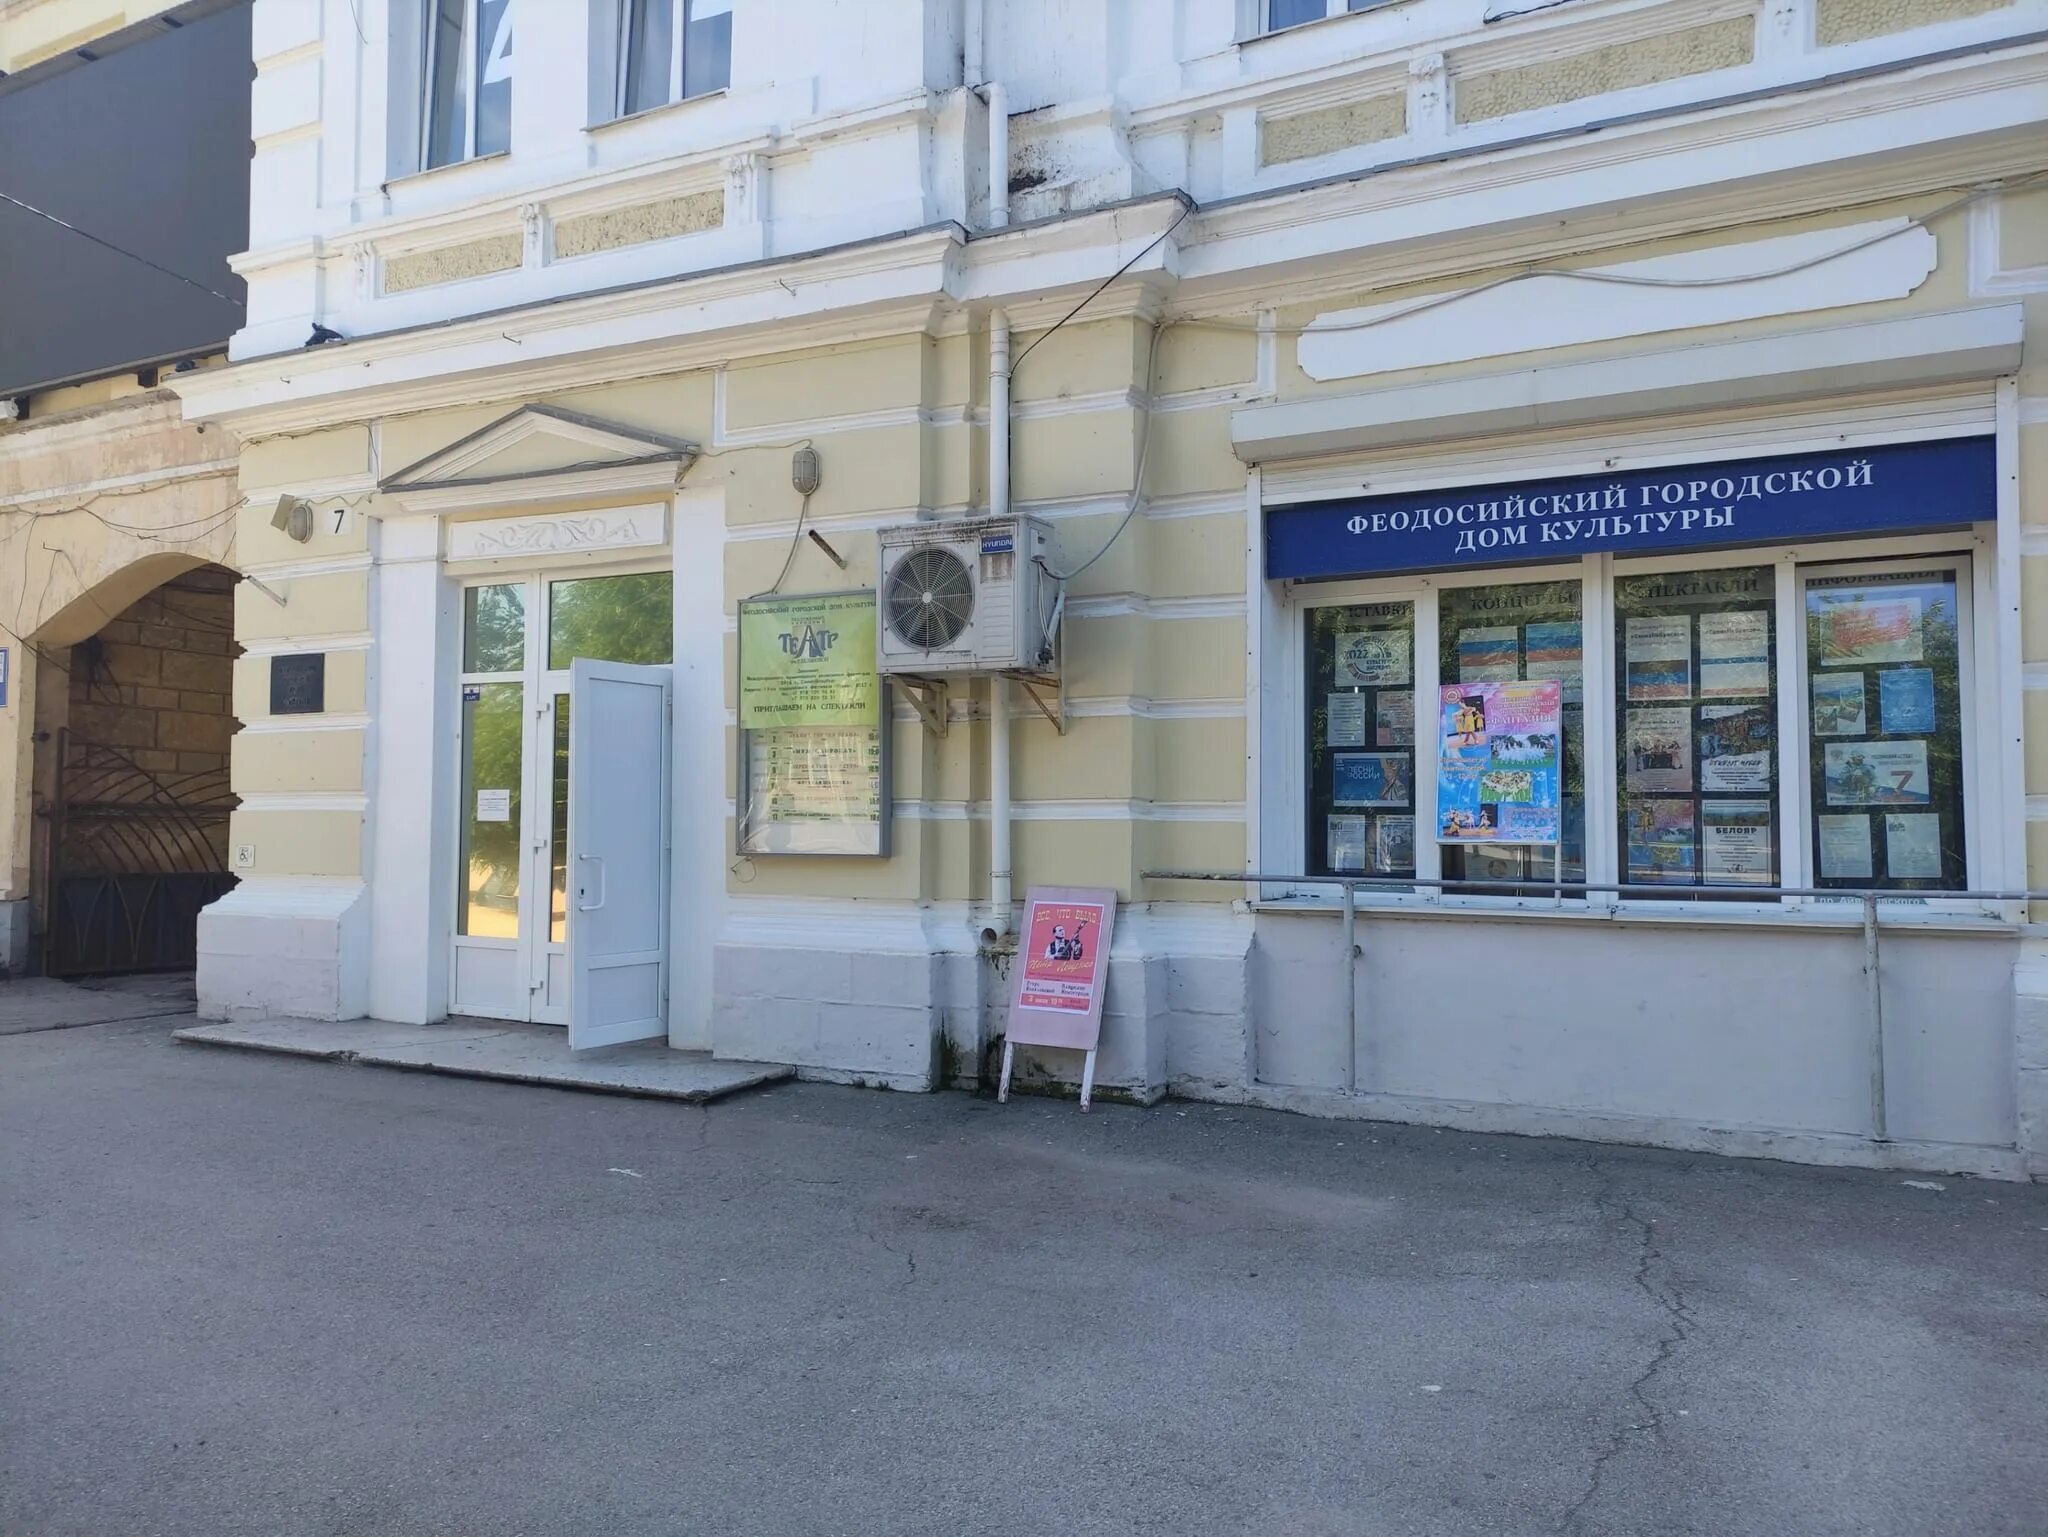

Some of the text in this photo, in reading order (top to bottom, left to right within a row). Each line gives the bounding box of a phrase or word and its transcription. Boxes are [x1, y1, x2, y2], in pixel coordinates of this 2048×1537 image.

[1347, 459, 1875, 535] ФЕОДОСИЙСКИЙ ГОРОДСКОЙ
[334, 509, 345, 534] 7
[1455, 506, 1736, 554] ДОМ КУЛЬТУРЫ
[754, 704, 802, 713] ПРИГЛАШАЕМ
[1715, 827, 1758, 835] БЕЛОЯР
